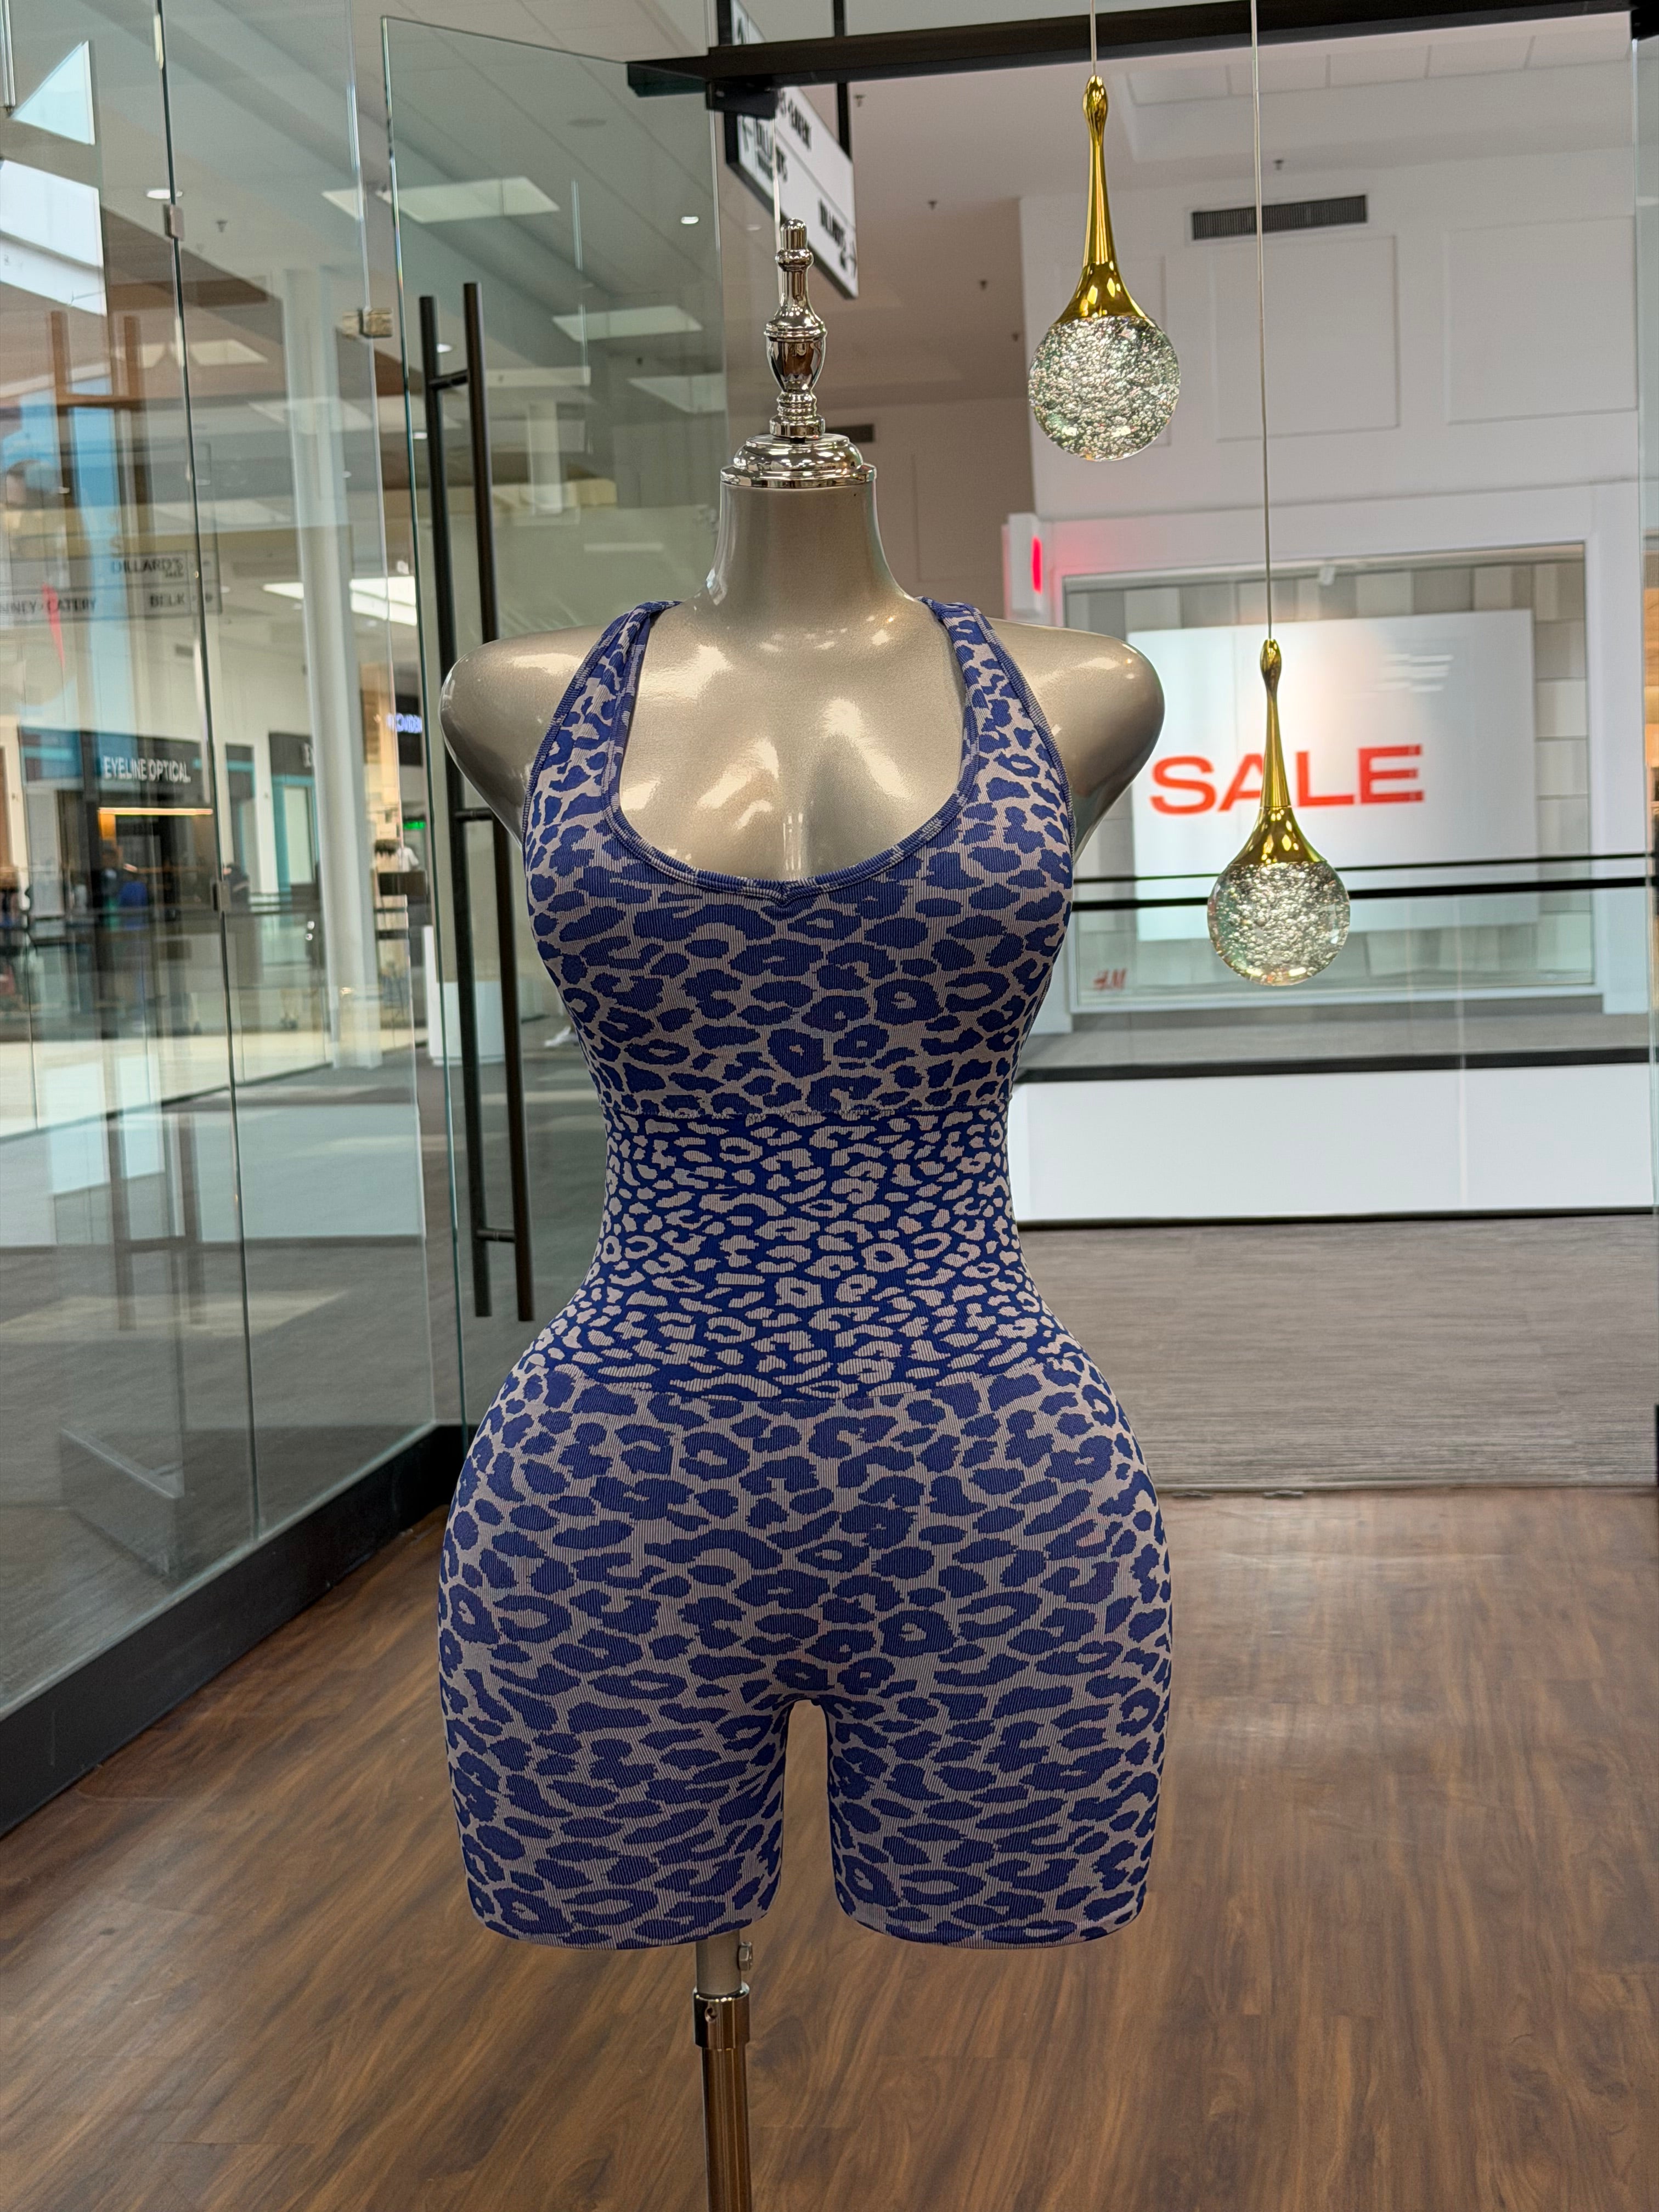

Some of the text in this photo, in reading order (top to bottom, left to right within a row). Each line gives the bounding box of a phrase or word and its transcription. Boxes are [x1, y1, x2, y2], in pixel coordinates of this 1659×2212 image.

[103, 755, 191, 783] EYELINE OPTICAL
[1150, 744, 1425, 815] SALE
